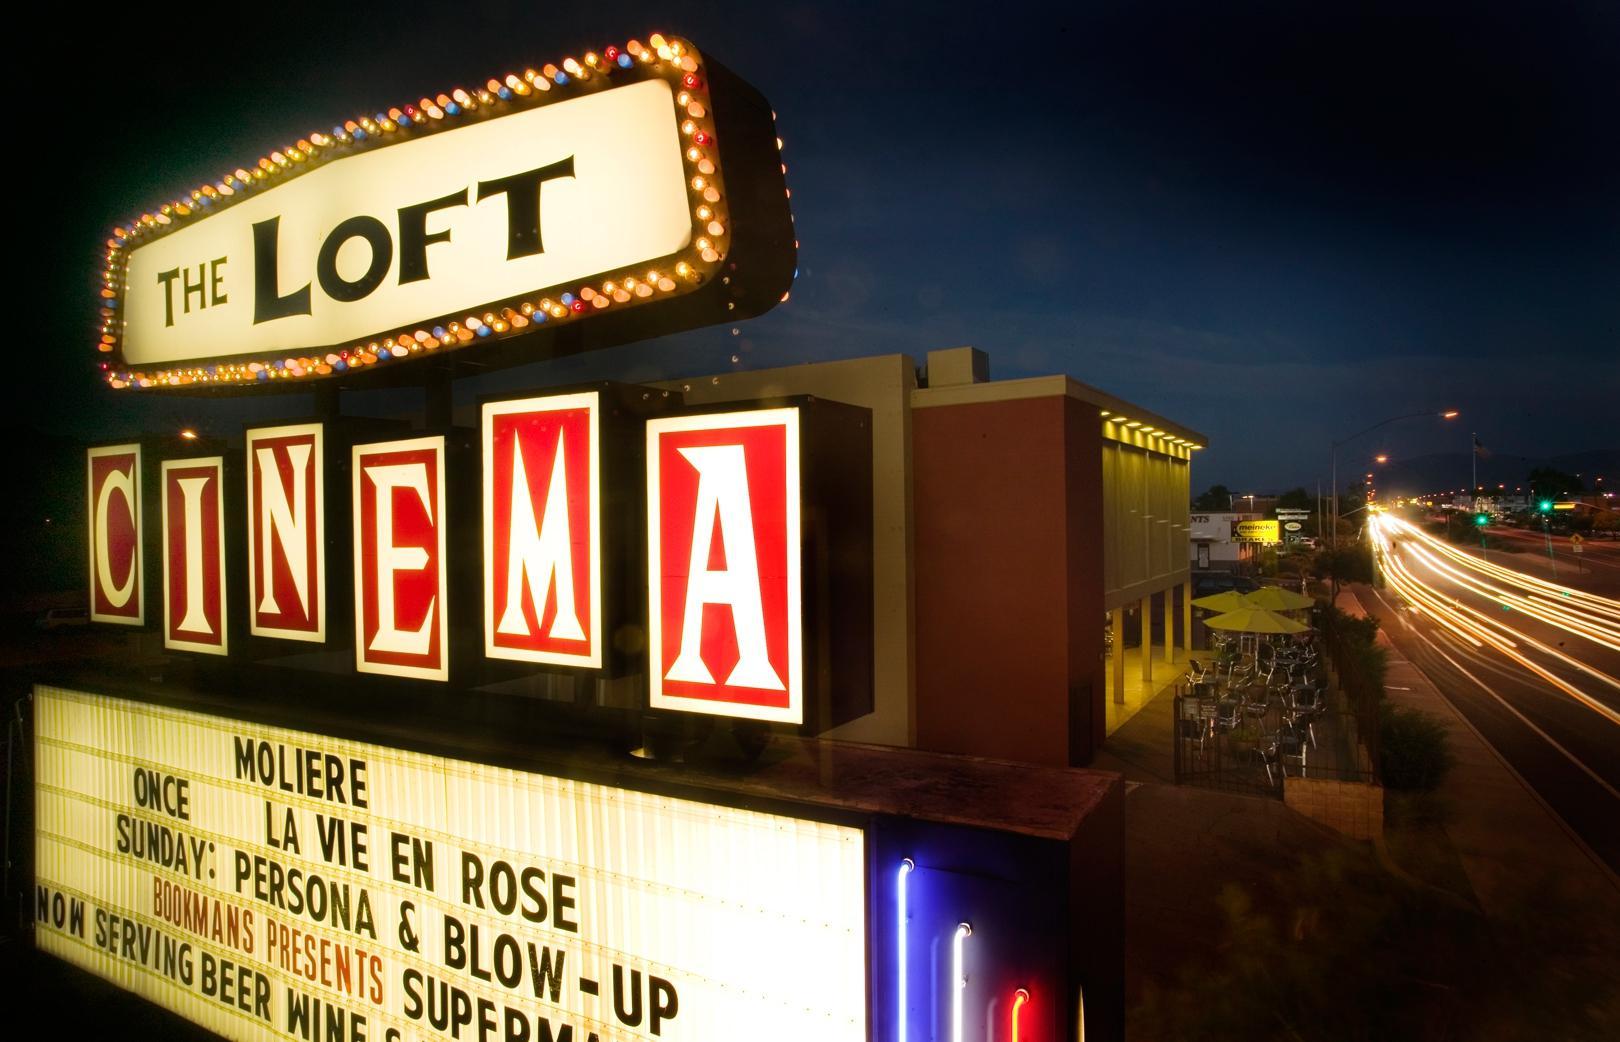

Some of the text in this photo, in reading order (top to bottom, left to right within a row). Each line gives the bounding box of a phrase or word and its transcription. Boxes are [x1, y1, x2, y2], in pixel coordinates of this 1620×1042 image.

[157, 154, 576, 327] THE LOFT
[96, 424, 788, 691] CINEMA
[134, 767, 578, 933] ONCE LA VIE EN ROSE
[234, 735, 368, 809] MOLIERE
[37, 885, 367, 1042] NOW SERVING BEER WINE
[116, 814, 215, 880] SUNDAY:
[235, 850, 377, 940] PERSONA
[398, 900, 420, 954] &
[153, 876, 600, 1042] BOOKMANS PRESENTS SUPER
